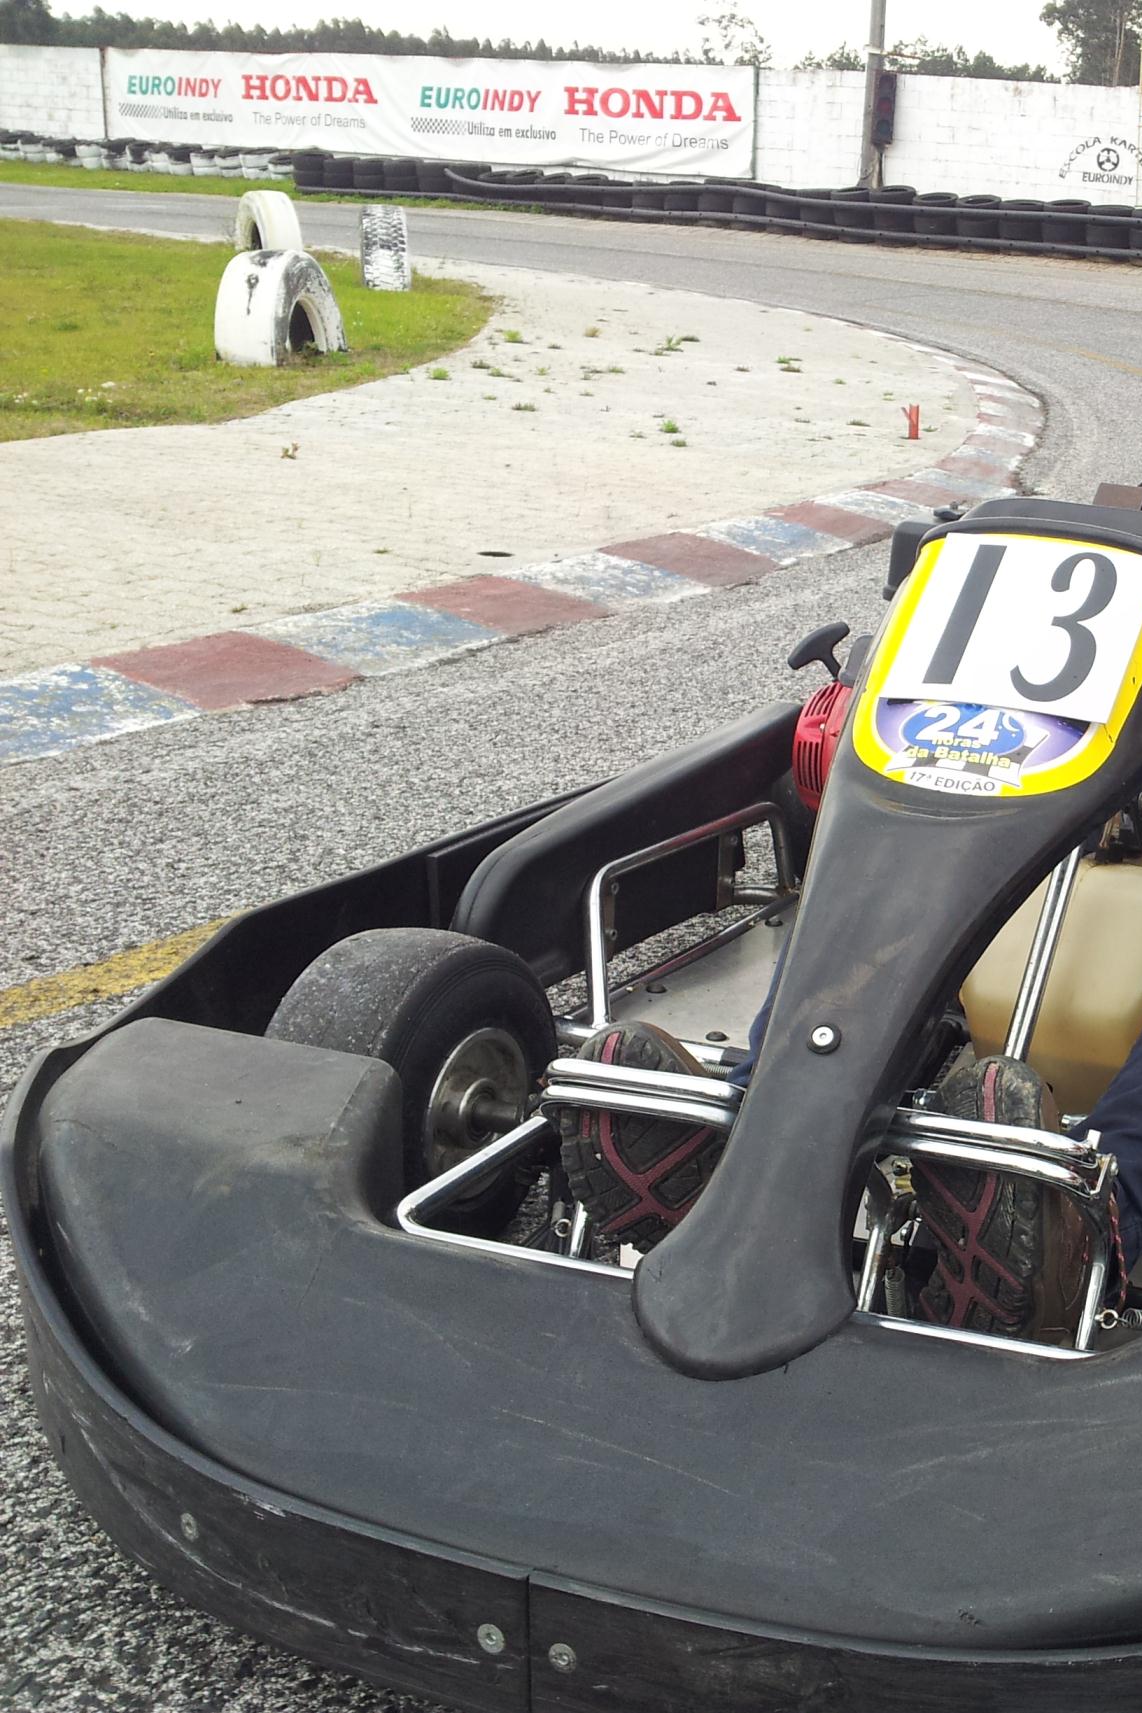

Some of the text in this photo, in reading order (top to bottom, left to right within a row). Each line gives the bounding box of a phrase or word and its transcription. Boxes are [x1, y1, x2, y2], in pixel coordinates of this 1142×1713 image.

[127, 75, 222, 98] EUROINDY
[241, 74, 378, 104] HONDA
[419, 86, 541, 113] EUROINDY
[564, 86, 742, 122] HONDA
[163, 107, 233, 123] Utiliza em exclusivo
[253, 111, 366, 129] The Power of Dreams
[467, 122, 556, 141] Utiliza em exclusivo
[579, 128, 729, 150] The Power of Dreams
[1059, 136, 1102, 179] ESCOLA
[1082, 172, 1134, 185] EUROINDY
[922, 544, 1118, 702] 13
[915, 705, 1000, 746] 24
[906, 745, 1011, 768] da Batalha
[934, 776, 996, 793] EDIÇÃO
